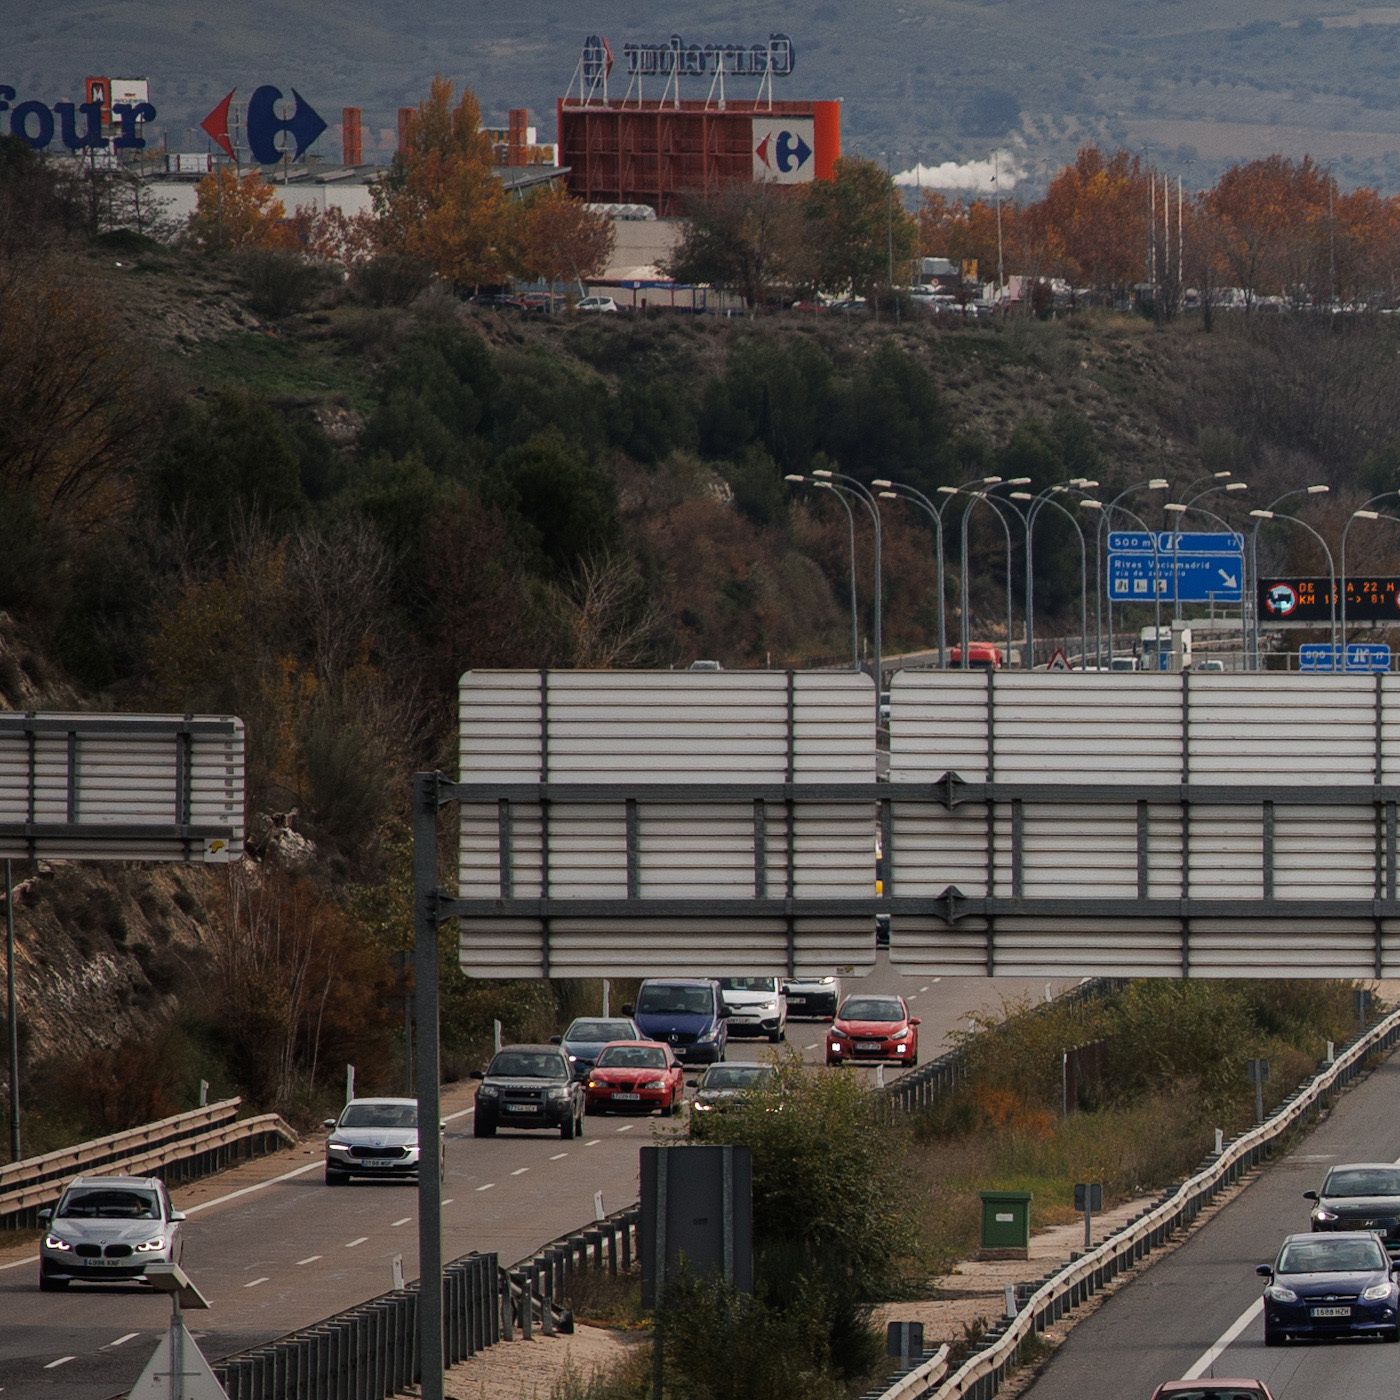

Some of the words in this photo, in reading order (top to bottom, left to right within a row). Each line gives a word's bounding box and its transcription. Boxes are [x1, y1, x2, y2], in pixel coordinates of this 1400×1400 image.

[1114, 538, 1139, 547] 500
[1299, 582, 1315, 592] DE
[1363, 582, 1378, 592] 22
[1299, 595, 1315, 605] KM
